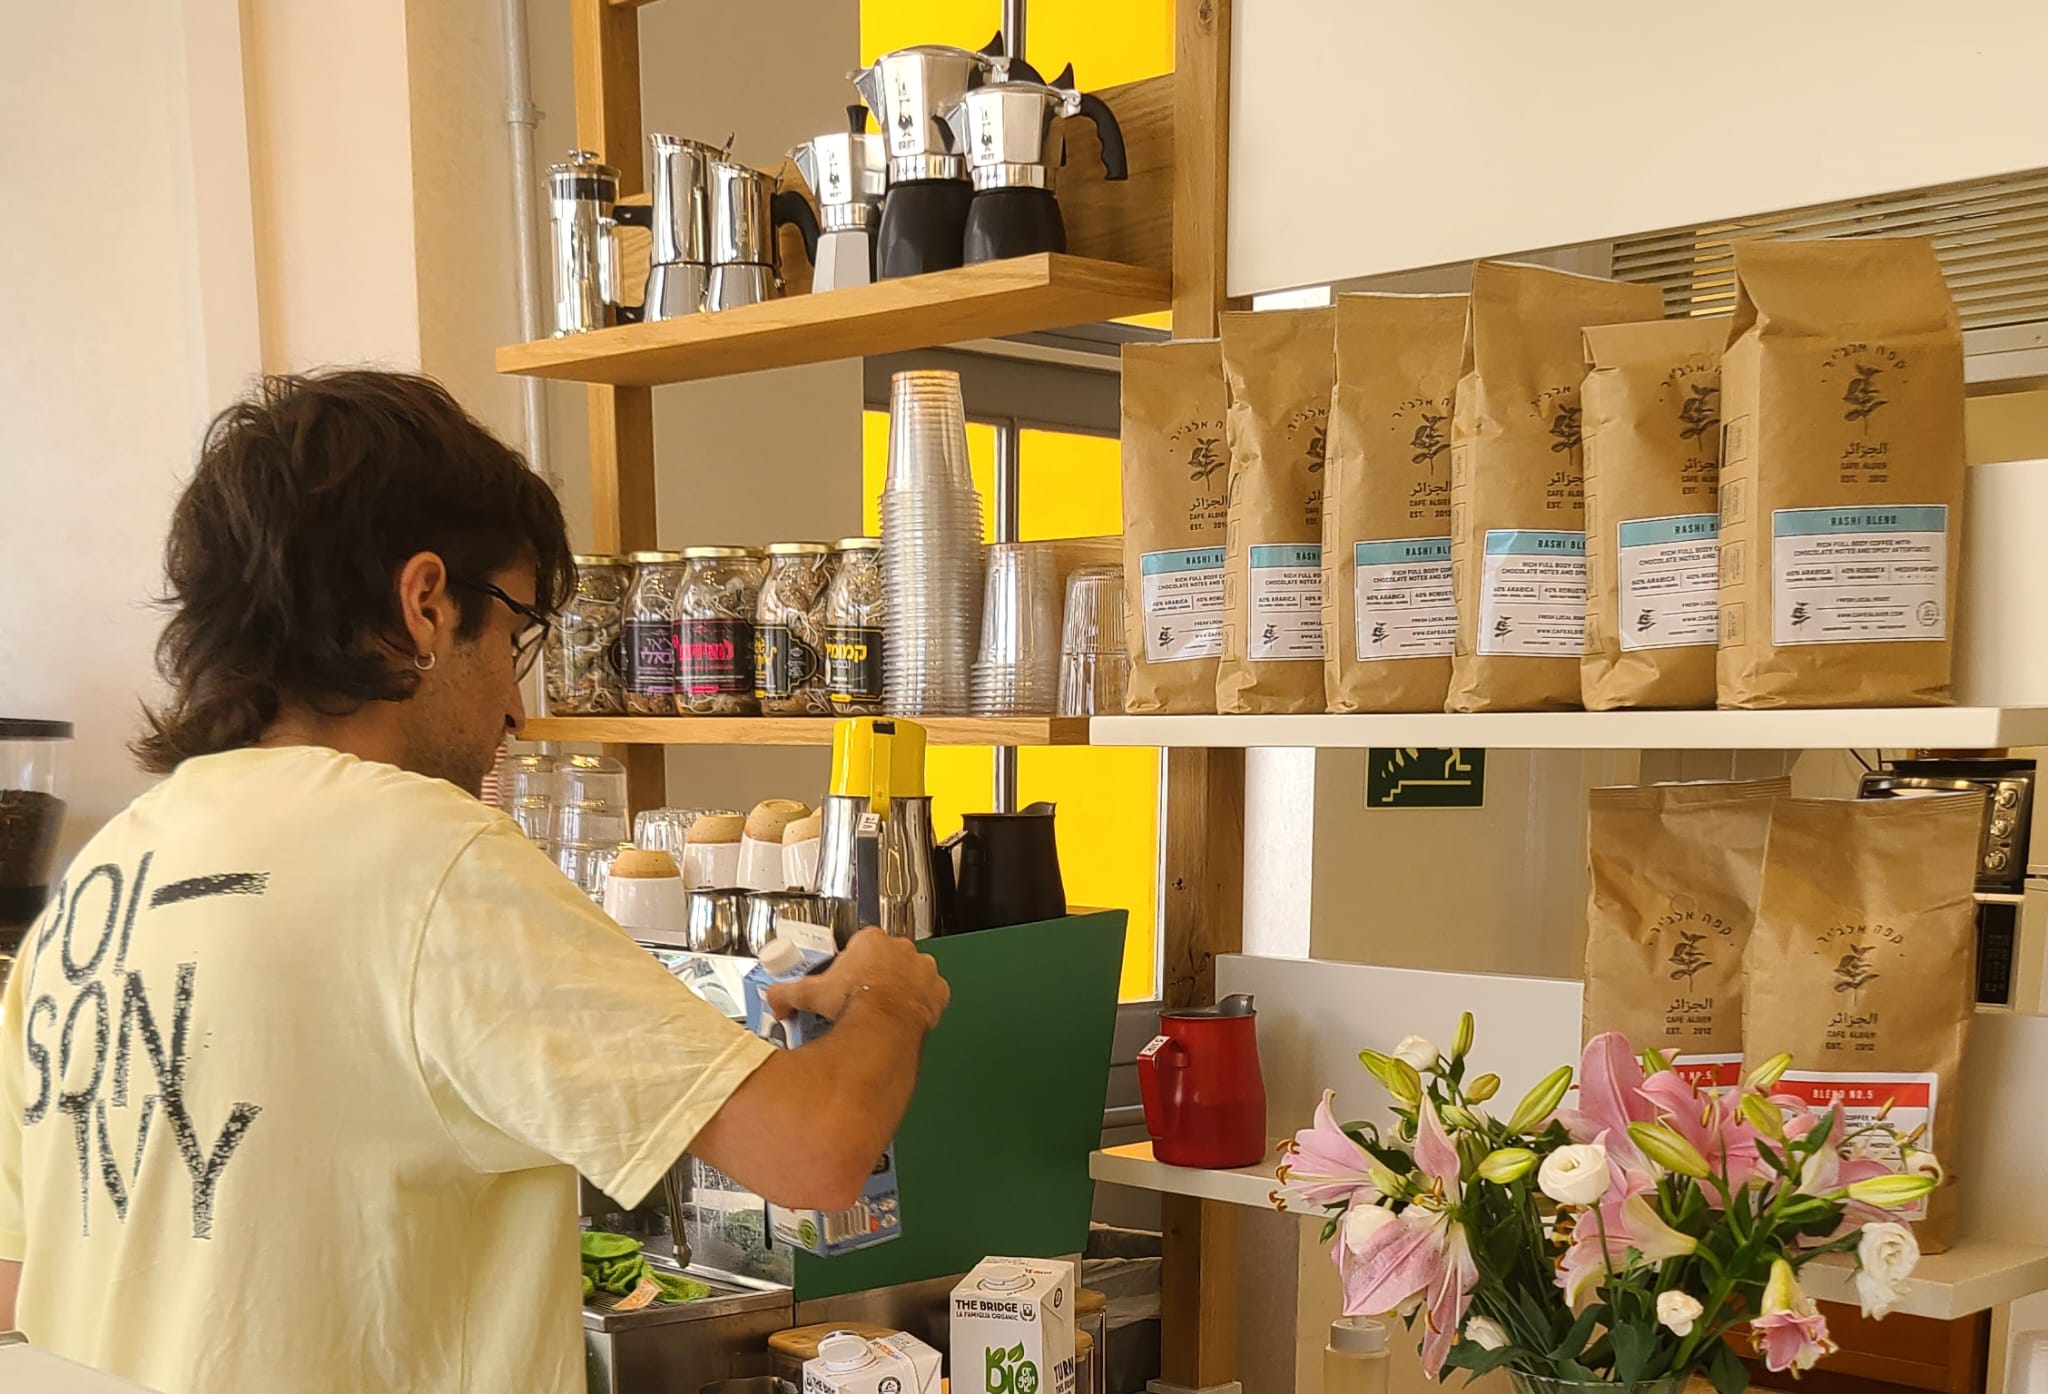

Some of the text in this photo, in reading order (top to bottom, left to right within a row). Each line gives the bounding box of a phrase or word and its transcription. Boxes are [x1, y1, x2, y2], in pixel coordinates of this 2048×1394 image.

[1841, 442, 1888, 458] الجزائر
[1410, 481, 1451, 496] الجزائر
[1831, 515, 1896, 526] RASHI BLEND
[1675, 524, 1704, 534] RASHI
[1538, 540, 1565, 549] RASHI
[1296, 552, 1320, 560] RASHI
[1406, 547, 1432, 556] RASHI
[1186, 556, 1210, 564] RASHI
[1639, 557, 1677, 566] CHOCOLATE
[1702, 913, 1732, 936] קפה
[1873, 925, 1904, 944] קפה
[1667, 998, 1712, 1013] الجزائر
[1828, 1012, 1878, 1027] الجزائر
[24, 962, 197, 1125] SON
[1813, 1088, 1873, 1099] BLEND NO.5
[956, 1300, 1018, 1312] THE BRIDGE
[1054, 1356, 1074, 1384] TURN
